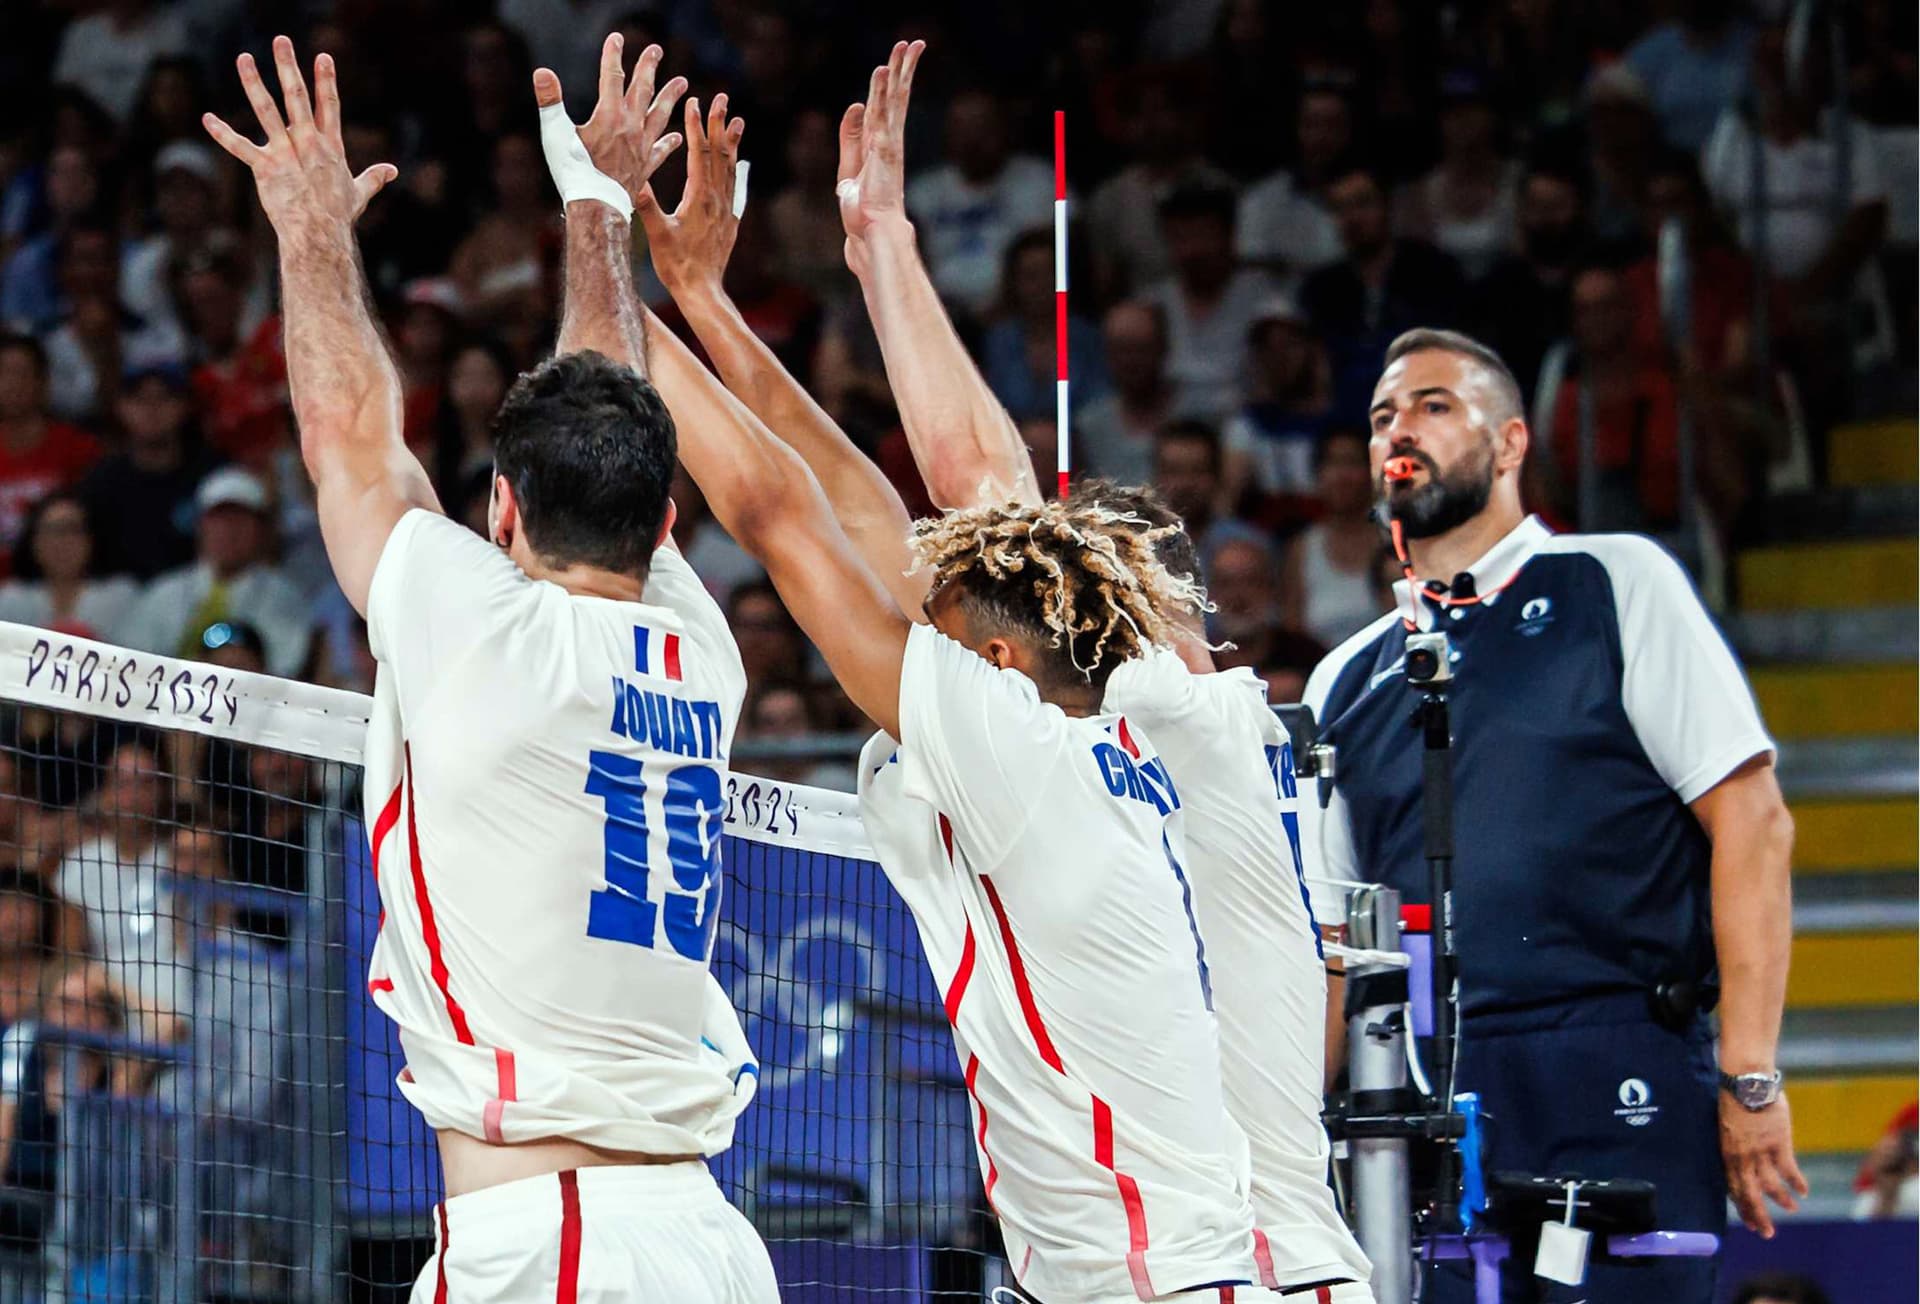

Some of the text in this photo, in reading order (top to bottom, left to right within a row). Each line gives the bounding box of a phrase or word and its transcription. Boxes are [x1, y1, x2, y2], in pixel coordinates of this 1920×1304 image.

[26, 639, 238, 726] PARIS 2024
[723, 777, 798, 835] 2024
[584, 749, 728, 962] 19
